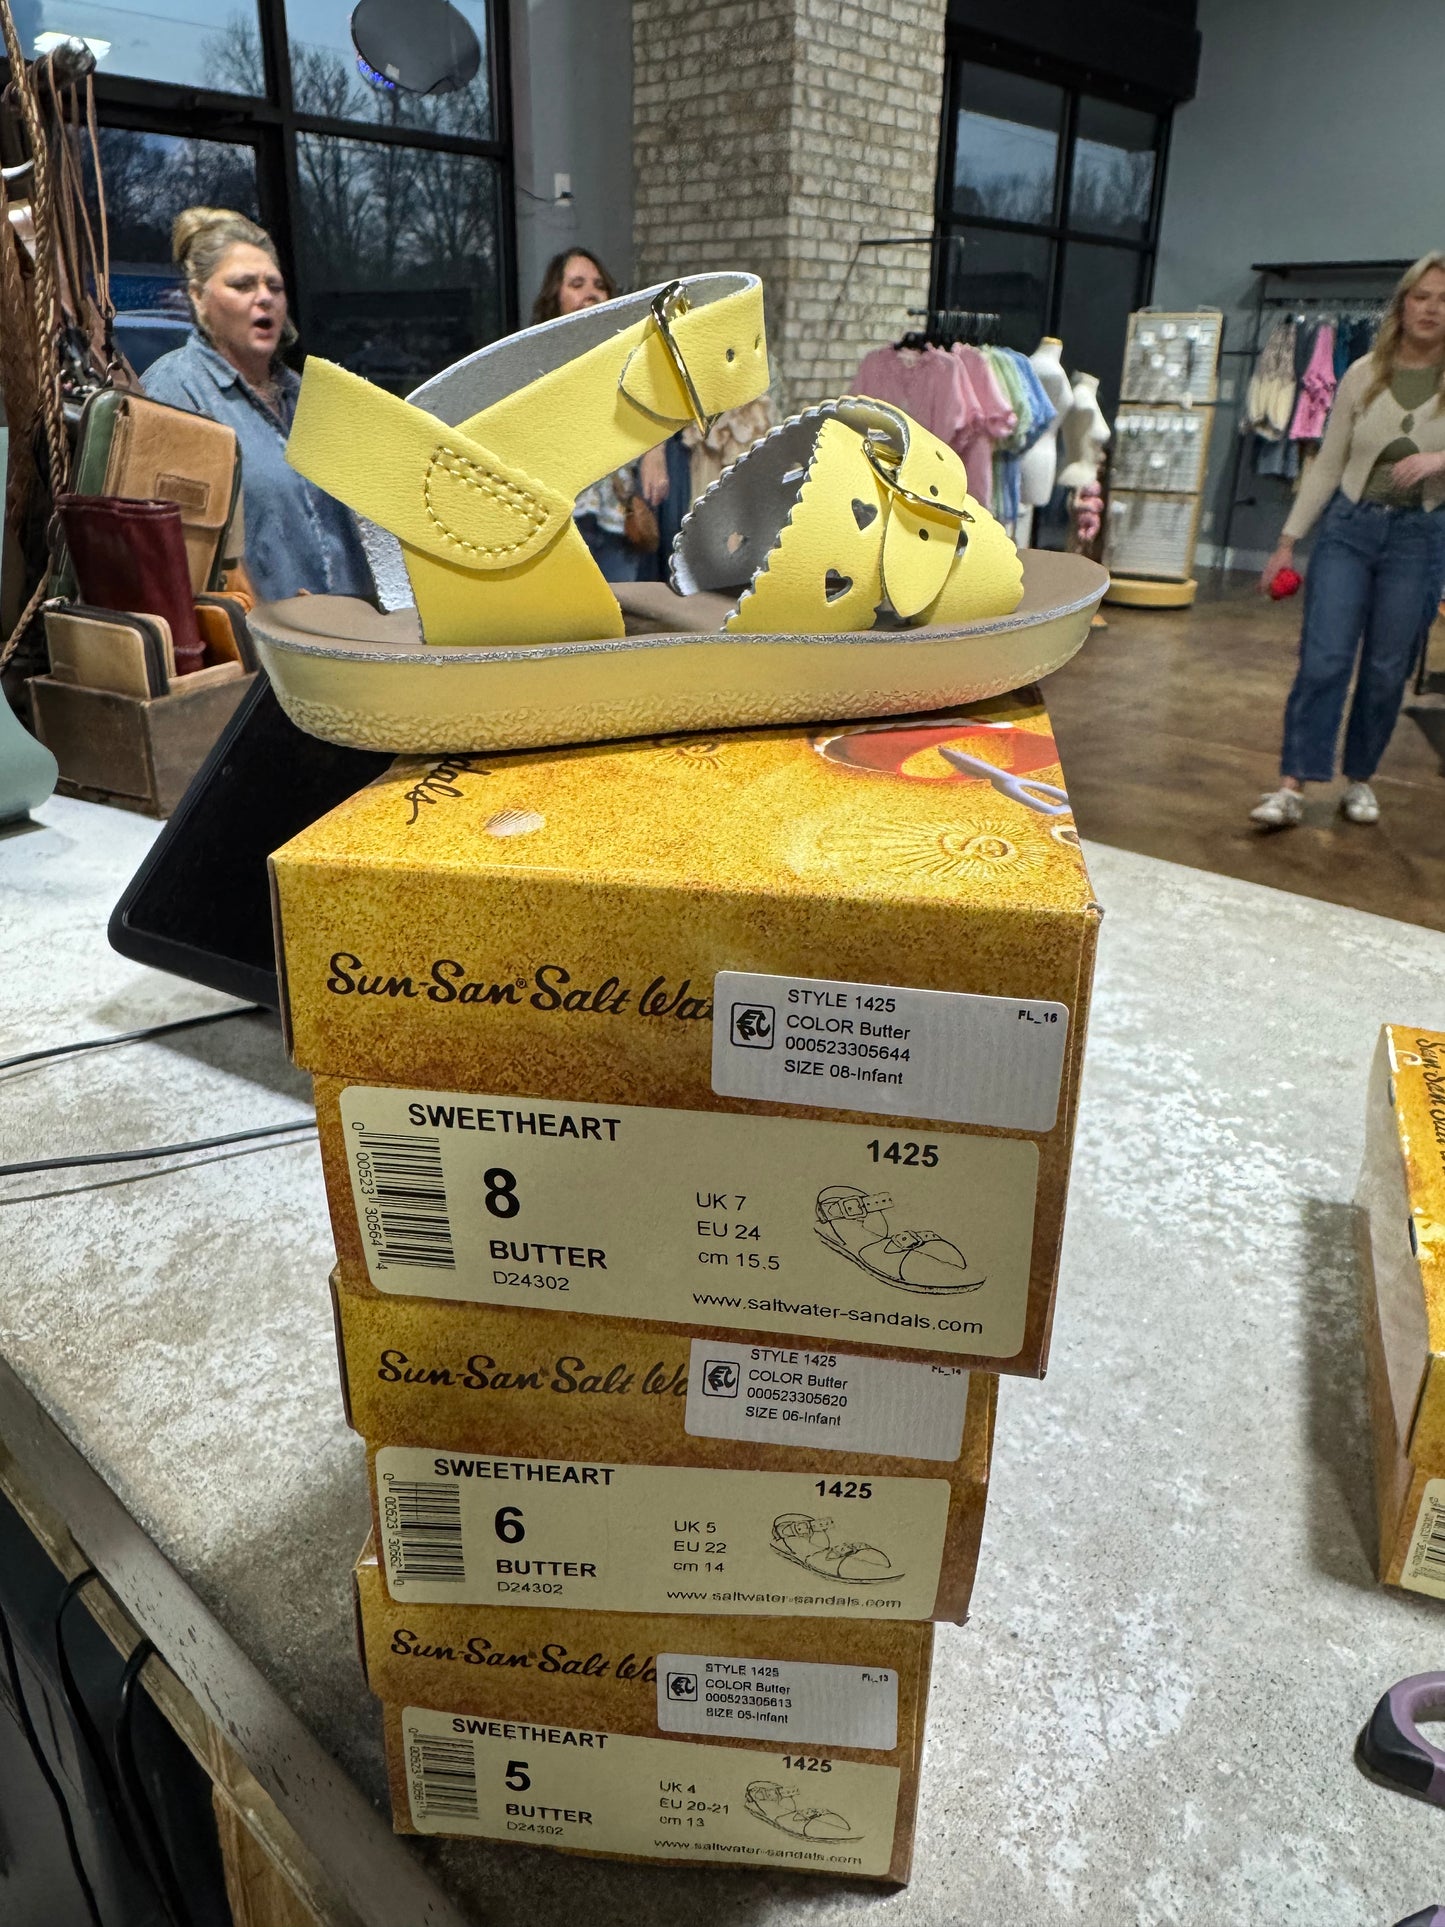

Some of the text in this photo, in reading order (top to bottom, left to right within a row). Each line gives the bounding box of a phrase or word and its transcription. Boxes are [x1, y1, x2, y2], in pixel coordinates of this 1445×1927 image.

[404, 754, 492, 825] dals
[530, 965, 630, 1015] Salt
[639, 976, 713, 1021] Wa
[788, 989, 897, 1013] STYLE 1425
[786, 1014, 911, 1041] COLOR Butter
[785, 1036, 911, 1062] 000523305644
[784, 1059, 904, 1085] SIZE 08-Infant
[408, 1103, 621, 1142] SWEETHEART
[867, 1139, 939, 1168] 1425
[356, 1152, 375, 1196] 00523
[483, 1167, 521, 1219] 8
[696, 1191, 747, 1211] UK 7
[364, 1206, 384, 1247] 30564
[697, 1220, 761, 1241] EU 24
[489, 1239, 608, 1270] BUTTER
[698, 1251, 780, 1271] cm 15.5
[493, 1271, 570, 1291] D24302
[692, 1292, 984, 1335] www.saltwater-sandals.com
[750, 1348, 837, 1368] STYLE 1425
[550, 1356, 635, 1394] Salt
[749, 1369, 849, 1389] COLOR Butter
[747, 1387, 848, 1407] 000523305620
[745, 1406, 842, 1426] SIZE 06-Infant
[434, 1458, 616, 1486] SWEETHEART
[815, 1480, 873, 1499] 1425
[494, 1506, 526, 1544] 6
[674, 1520, 717, 1534] UK 5
[674, 1540, 727, 1554] EU 22
[496, 1559, 597, 1578] BUTTER
[673, 1562, 725, 1573] cm 14
[497, 1581, 563, 1596] D24302
[537, 1644, 612, 1677] Salt
[705, 1662, 747, 1676] STYLE
[705, 1679, 791, 1695] COLOR Butter
[706, 1708, 734, 1719] SIZE
[452, 1718, 609, 1749] SWEETHEART
[782, 1755, 832, 1773] 1425
[505, 1760, 531, 1792] 5
[659, 1780, 696, 1794] UK 4
[505, 1803, 593, 1825] BUTTER
[659, 1797, 730, 1815] EU 20-21
[659, 1815, 705, 1827] cm 13
